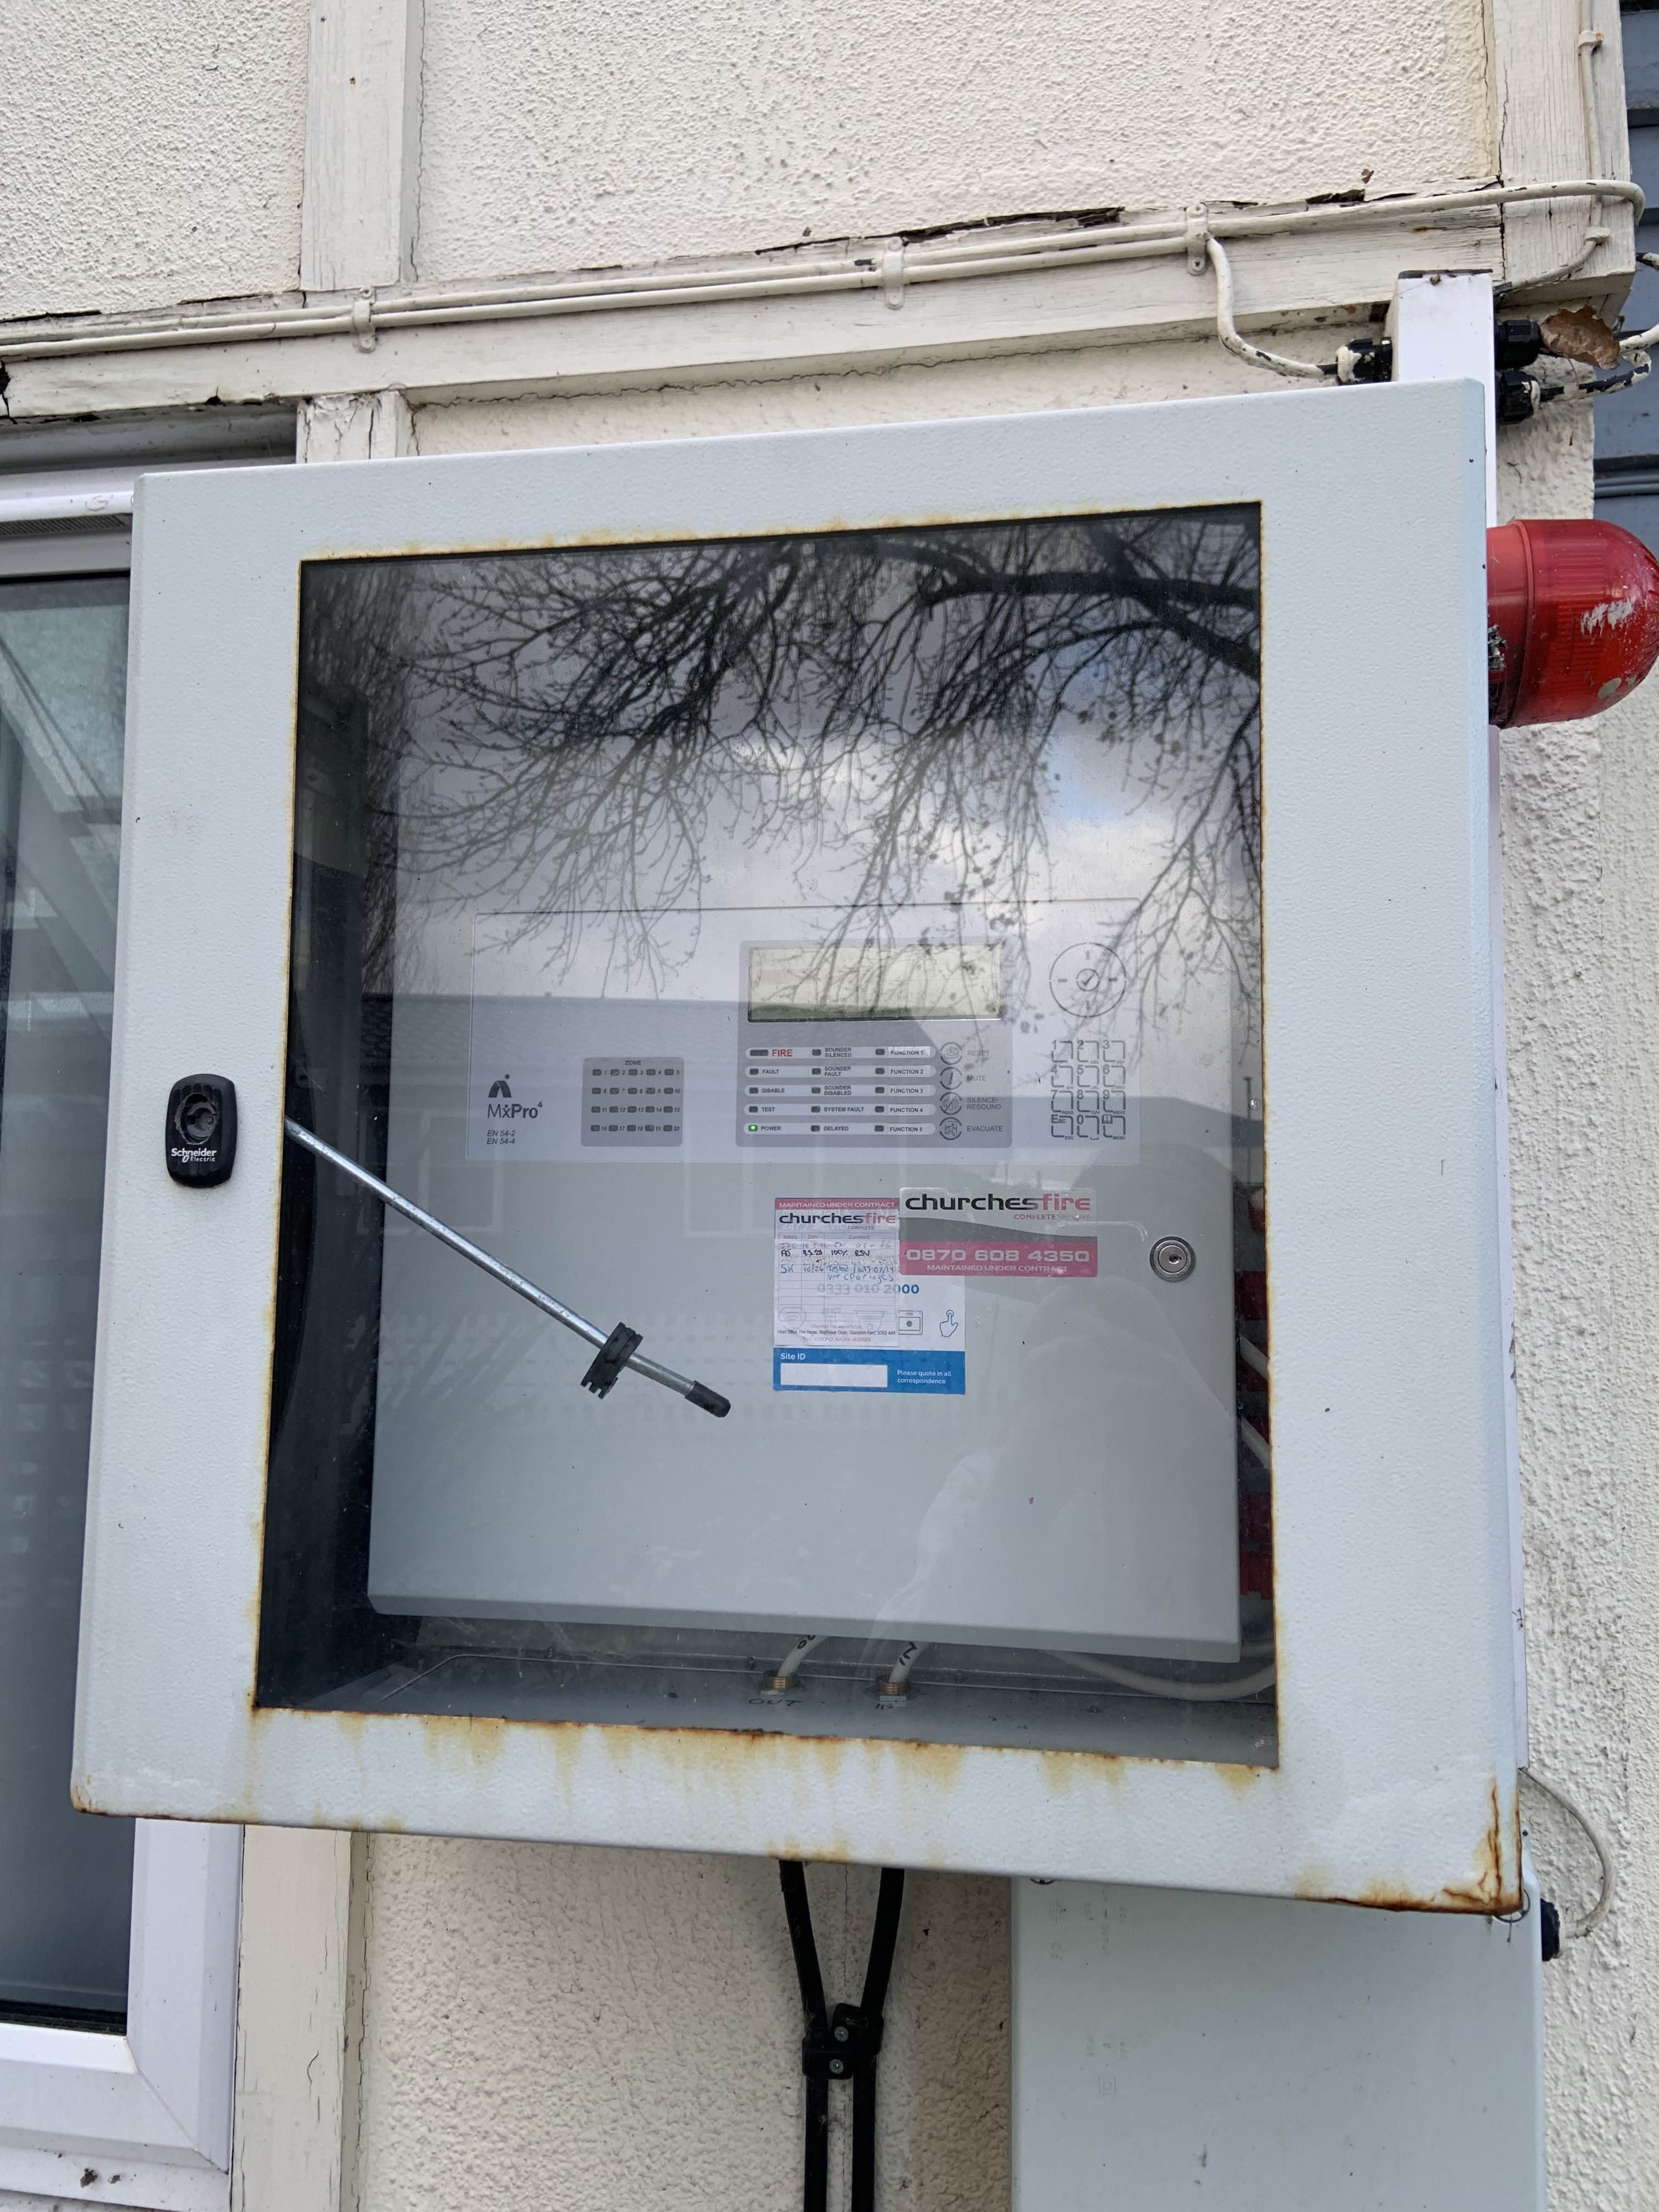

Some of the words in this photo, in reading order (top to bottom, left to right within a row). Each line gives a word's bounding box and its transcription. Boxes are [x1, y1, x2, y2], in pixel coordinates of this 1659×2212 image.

[1051, 1040, 1057, 1050] 1
[1076, 1040, 1084, 1050] 2
[1103, 1039, 1110, 1049] 3
[1051, 1064, 1058, 1075] 4
[1076, 1064, 1084, 1075] 5
[1103, 1064, 1110, 1075] 6
[1051, 1090, 1058, 1100] 7
[1076, 1089, 1084, 1100] 8
[1103, 1089, 1110, 1099] 9
[1076, 1114, 1084, 1125] 0
[171, 1148, 217, 1156] Schneider
[905, 1193, 1091, 1211] churchesfire
[906, 1249, 966, 1261] 0870
[974, 1249, 1019, 1262] 608
[1028, 1250, 1090, 1262] 4350
[817, 1283, 850, 1295] 0333
[854, 1283, 881, 1294] 010
[883, 1284, 920, 1295] 2000
[781, 1352, 795, 1361] Site
[748, 1698, 803, 1707] OUT
